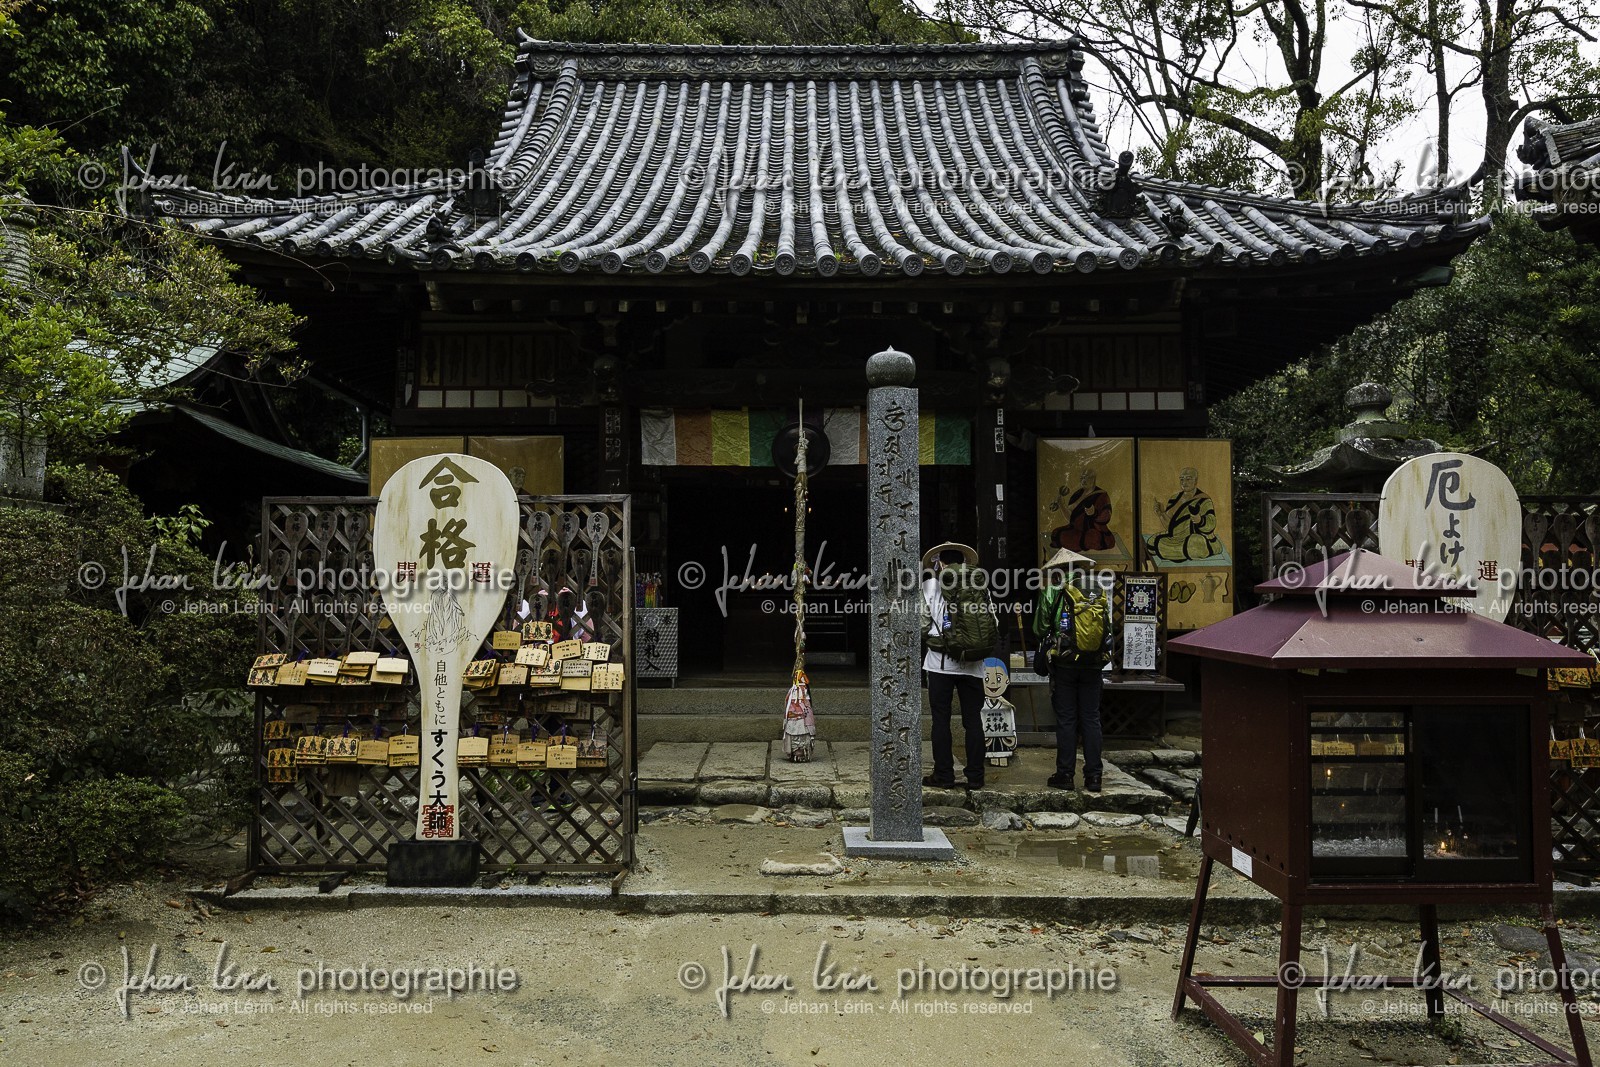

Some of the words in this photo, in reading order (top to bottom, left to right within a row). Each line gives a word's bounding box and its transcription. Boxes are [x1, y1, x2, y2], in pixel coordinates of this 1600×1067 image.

[419, 457, 480, 570] 合格
[592, 513, 603, 532] 合格
[1424, 459, 1477, 568] 厄よけ
[397, 561, 417, 584] 開
[470, 561, 491, 583] 運
[1478, 560, 1499, 582] 運
[643, 629, 661, 671] 納札入
[1144, 624, 1154, 667] 八福神まいり
[428, 659, 449, 829] 自他ともにすくう大師
[984, 722, 1009, 733] 大師堂
